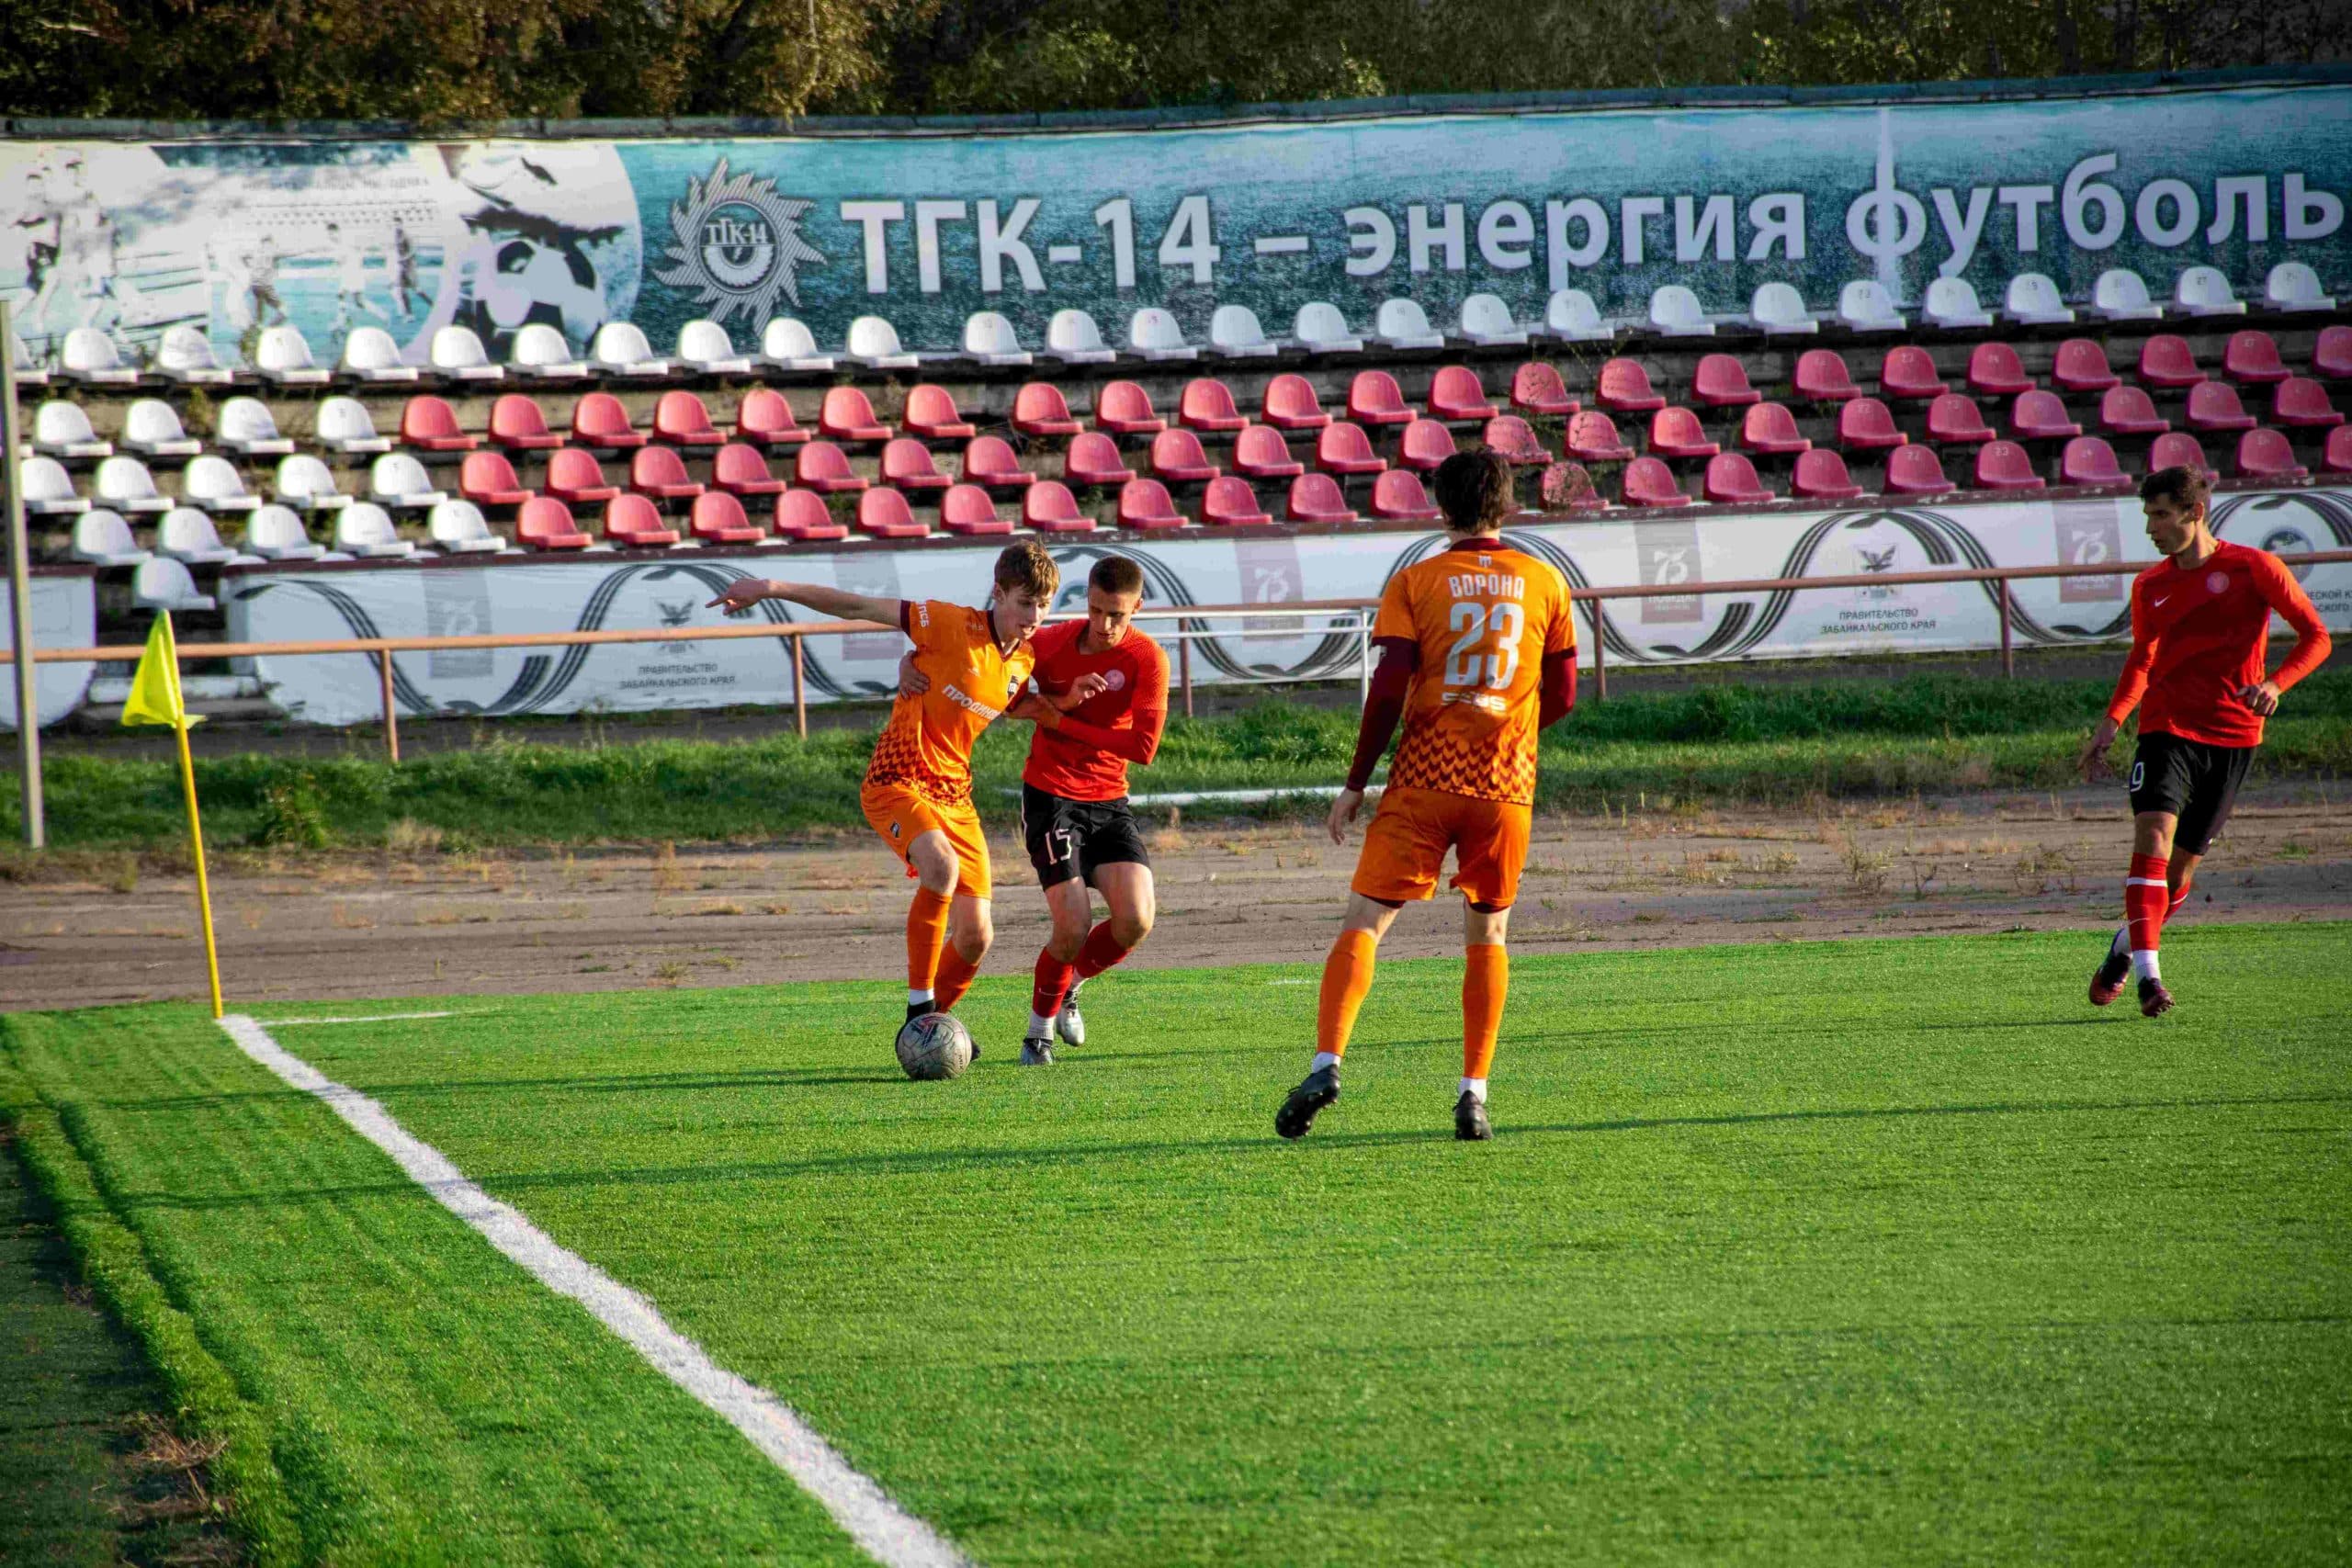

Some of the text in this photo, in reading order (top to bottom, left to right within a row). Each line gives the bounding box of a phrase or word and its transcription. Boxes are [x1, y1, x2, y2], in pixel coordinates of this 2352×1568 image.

[705, 217, 768, 244] ТГК-14
[840, 195, 1221, 293] ТГК-14
[1343, 193, 1806, 291] энергия
[1448, 573, 1525, 600] ВОРОНА
[1820, 620, 1937, 634] ЗАБАЙКАЛЬСКОГО КРАЯ
[1838, 607, 1918, 620] ПРАВИТЕЛЬСТВО
[1444, 602, 1525, 690] 23
[639, 663, 718, 675] ПРАВИТЕЛЬСТВО
[618, 676, 736, 690] ЗАБАЙКАЛЬСКОГО КРАЯ
[1045, 829, 1072, 865] 15
